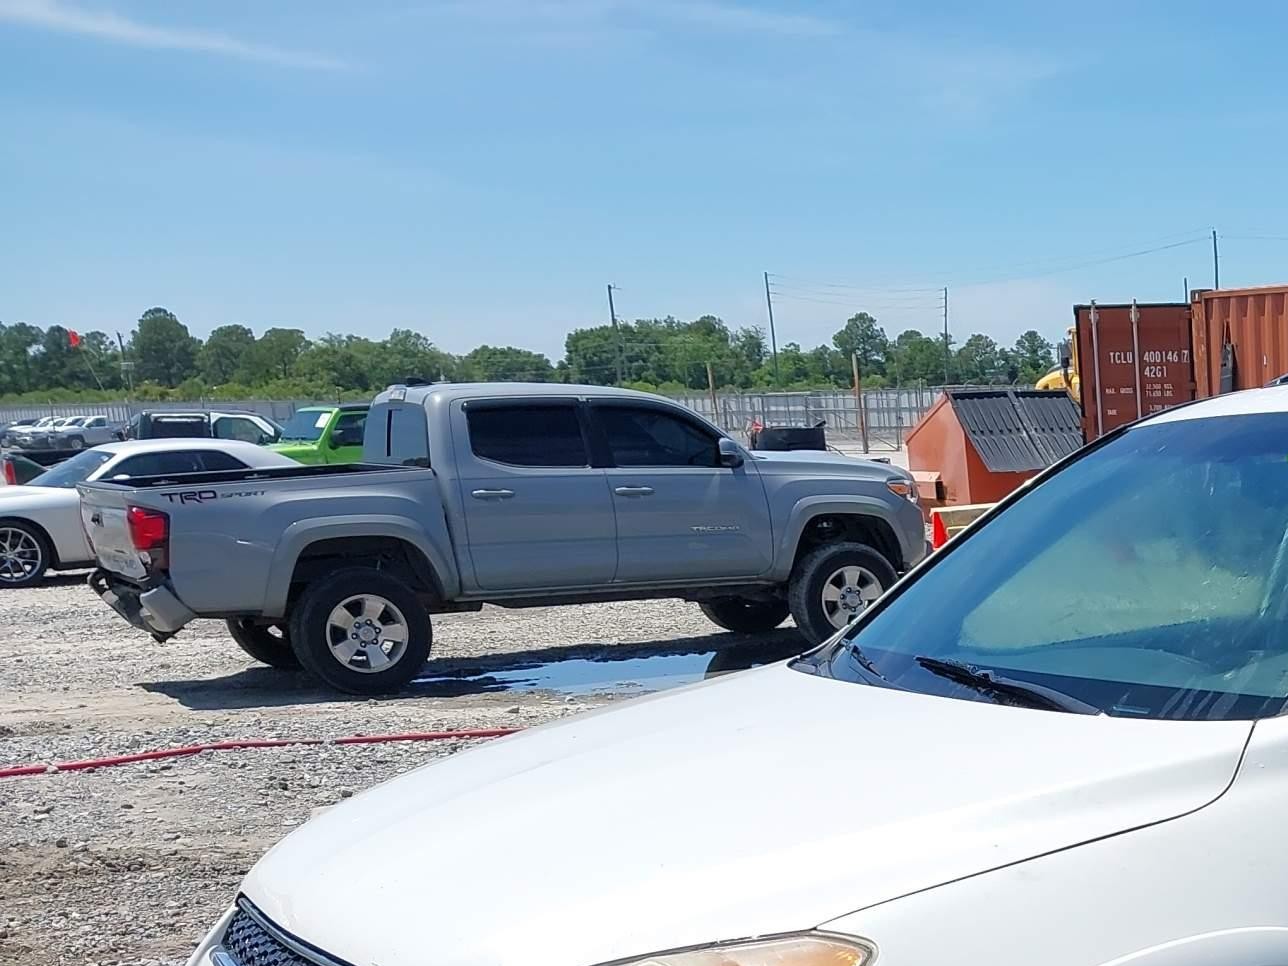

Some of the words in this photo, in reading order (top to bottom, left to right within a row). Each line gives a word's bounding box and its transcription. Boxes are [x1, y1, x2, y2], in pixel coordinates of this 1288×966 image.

[1110, 352, 1133, 364] TCLU
[1143, 351, 1178, 363] 400146
[1181, 350, 1190, 363] 7
[1144, 366, 1167, 377] 42G1
[160, 490, 217, 504] TRD
[220, 490, 266, 499] SPORT
